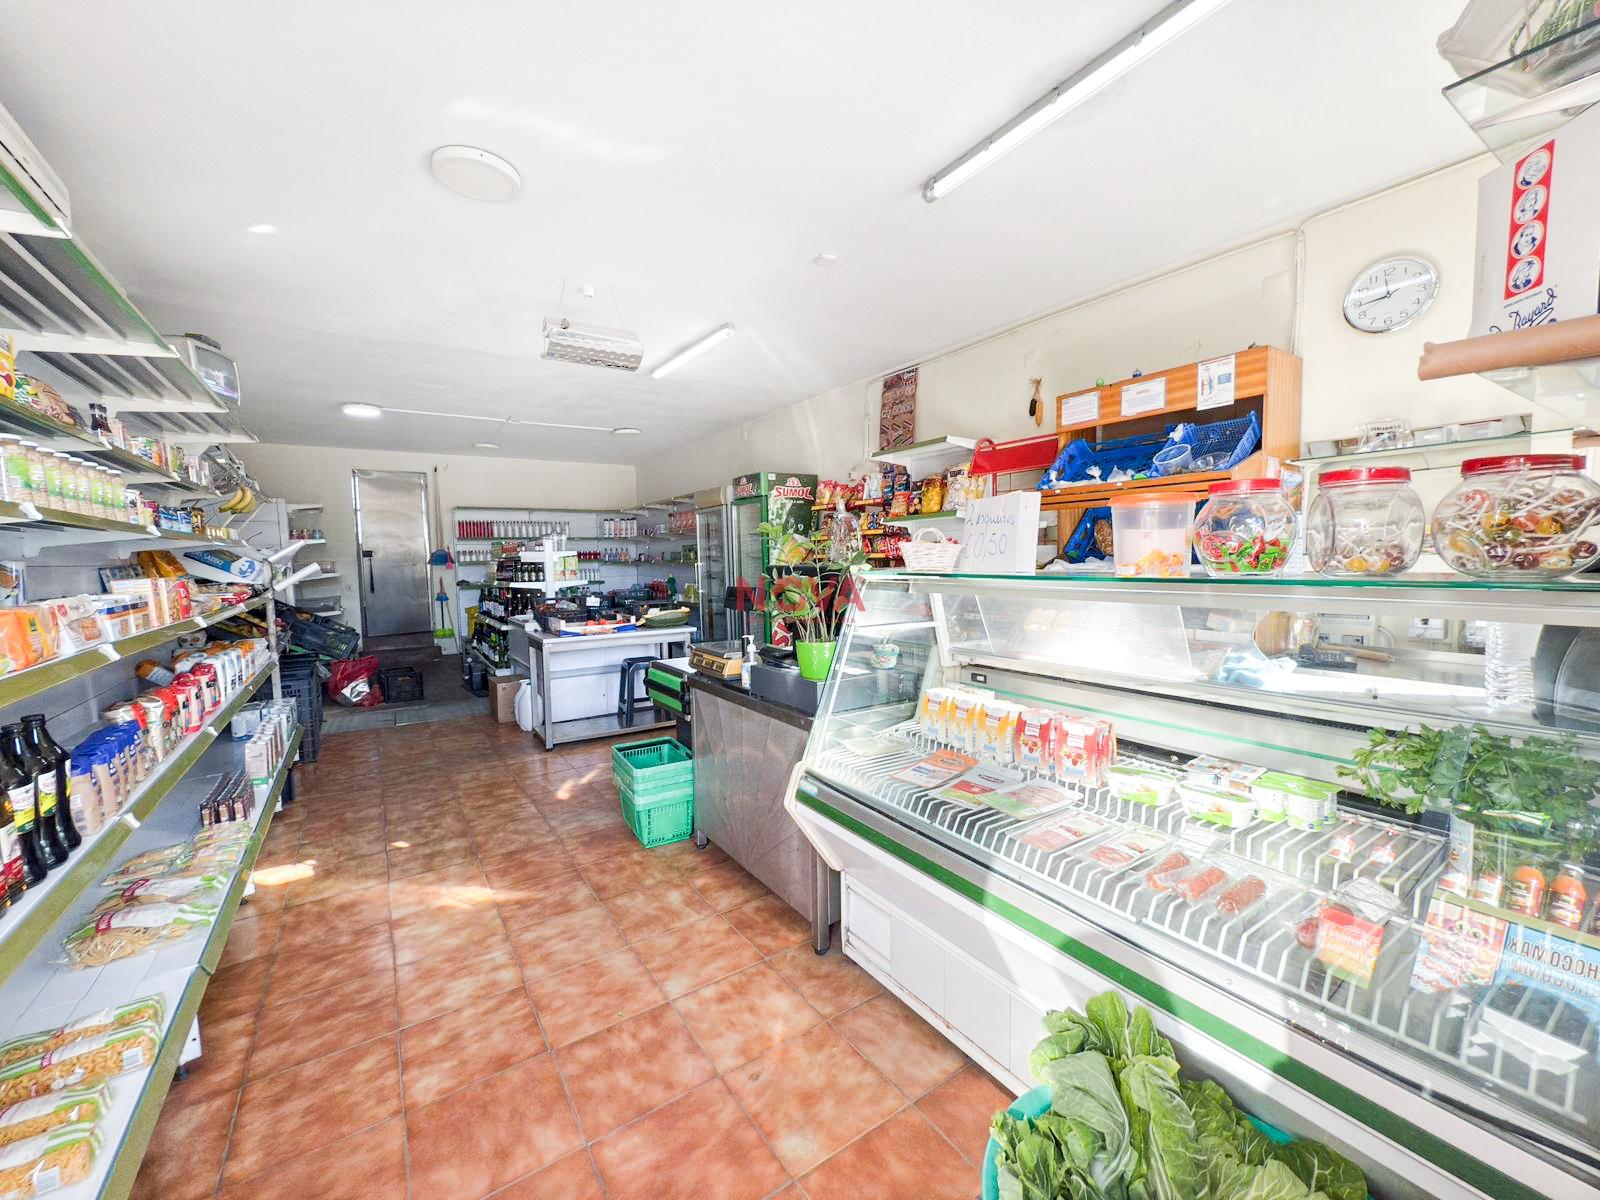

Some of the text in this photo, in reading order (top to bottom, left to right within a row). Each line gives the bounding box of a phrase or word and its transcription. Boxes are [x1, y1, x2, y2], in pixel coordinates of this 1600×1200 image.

[1369, 275, 1378, 284] 11
[1368, 317, 1377, 328] 7
[1384, 316, 1393, 325] 6
[774, 486, 814, 500] SUMOL
